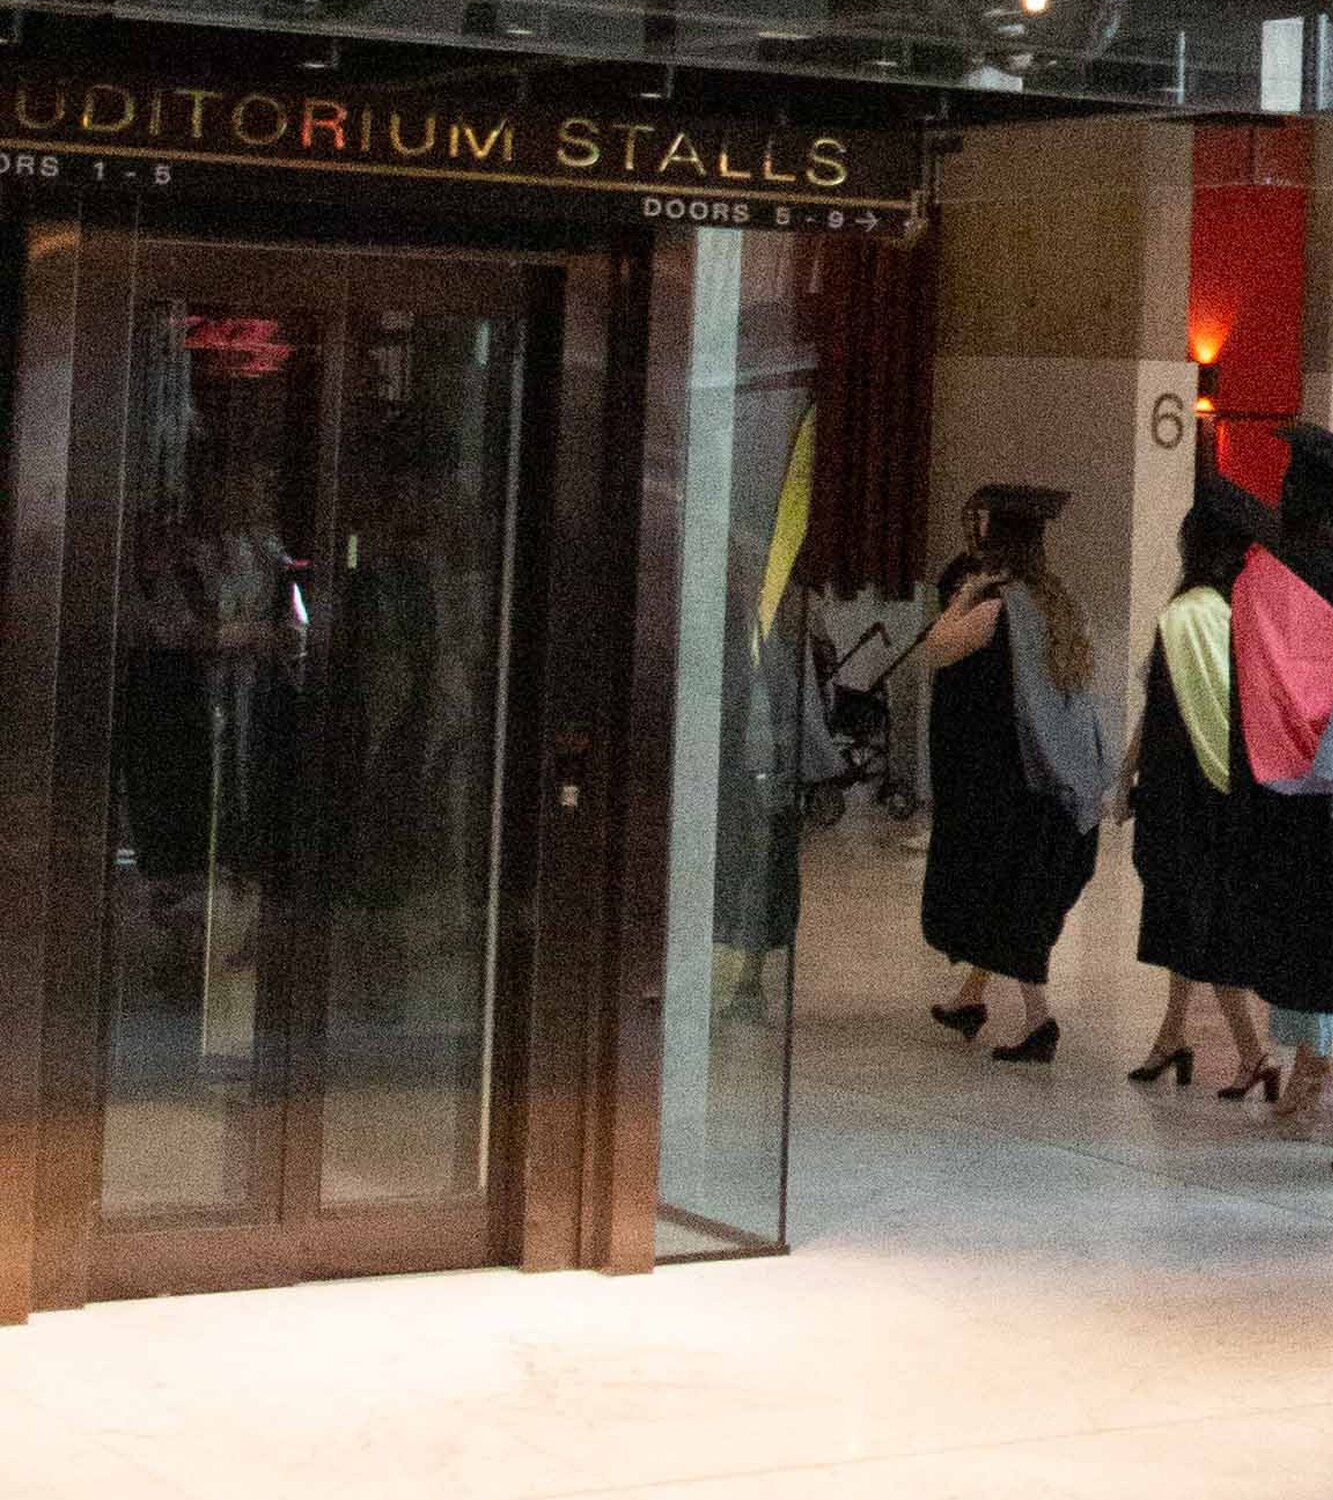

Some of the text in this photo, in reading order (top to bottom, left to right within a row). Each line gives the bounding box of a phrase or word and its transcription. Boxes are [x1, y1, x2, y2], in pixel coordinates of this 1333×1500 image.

[15, 83, 849, 186] UDITORIUM STALLS
[93, 160, 104, 181] 1
[154, 163, 172, 185] 5
[642, 196, 750, 222] DOORS
[775, 206, 791, 226] 5
[828, 209, 845, 230] 9
[1151, 392, 1184, 450] 6
